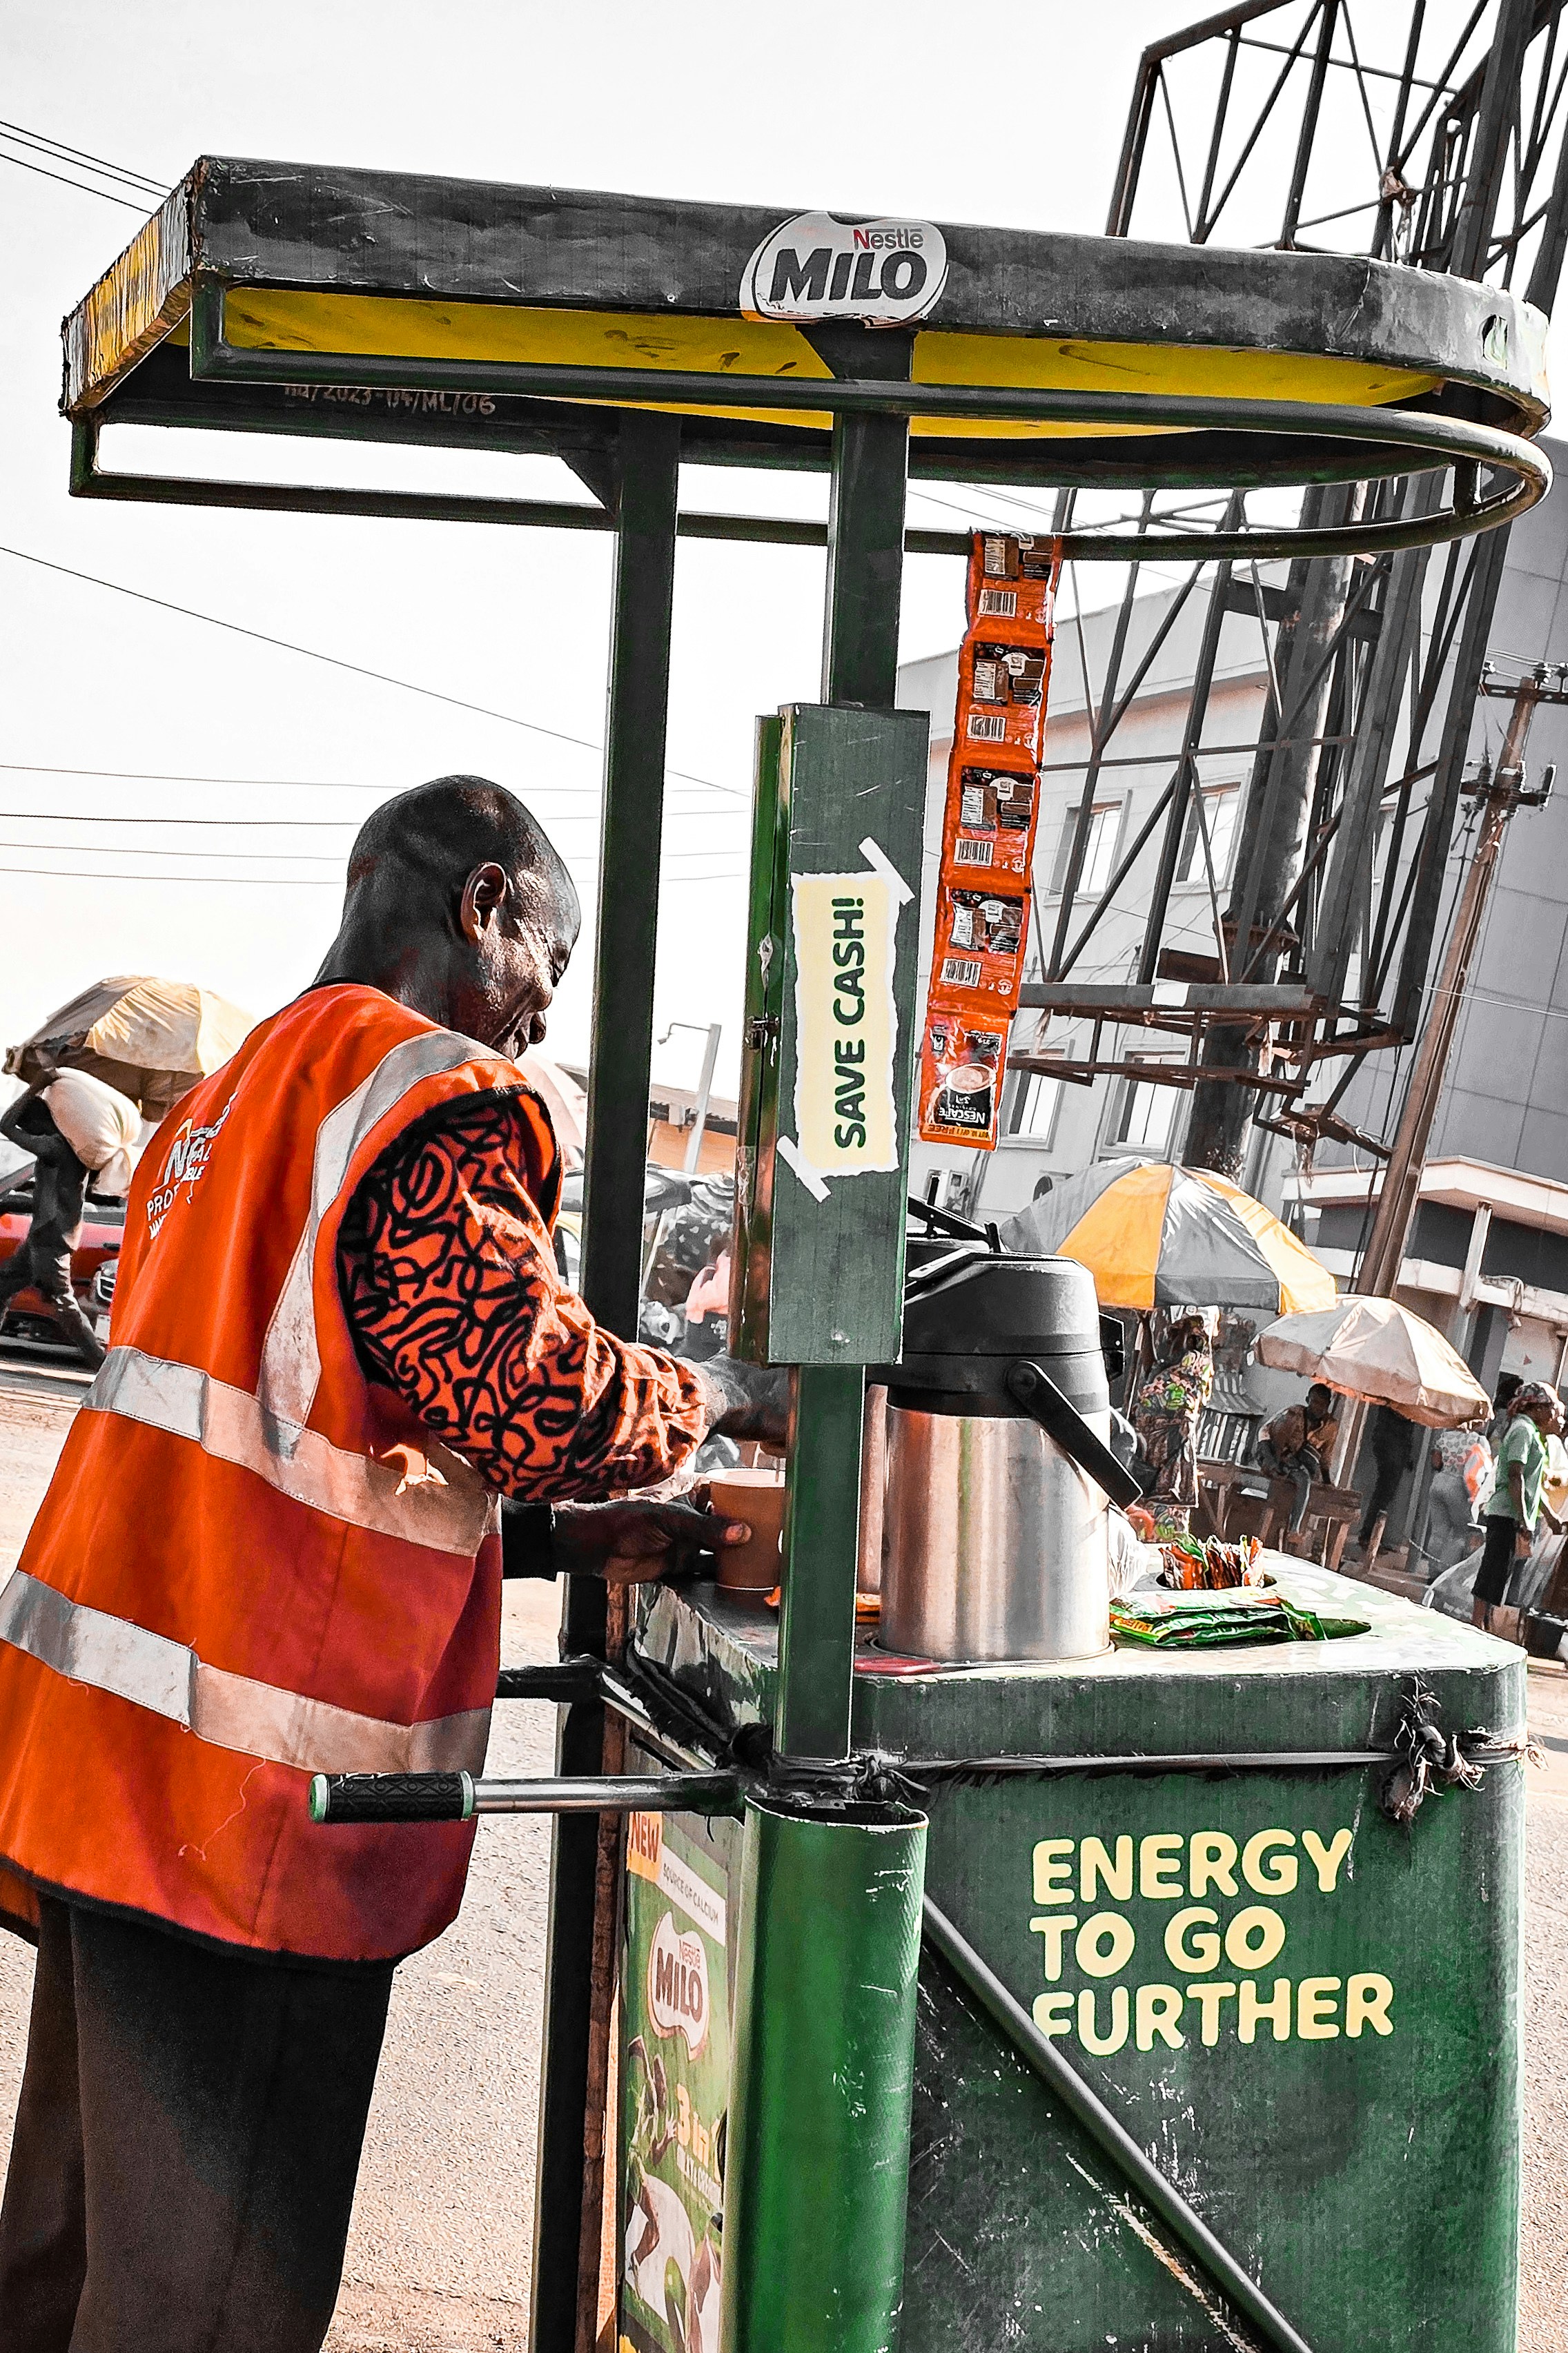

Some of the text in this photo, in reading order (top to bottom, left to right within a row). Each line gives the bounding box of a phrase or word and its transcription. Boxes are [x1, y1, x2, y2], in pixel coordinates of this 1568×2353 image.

[770, 248, 928, 302] MILO
[832, 897, 866, 1149] SAVE CASH!
[631, 1812, 660, 1863] NEW
[1032, 1828, 1353, 1905] ENERGY
[663, 1862, 719, 1926] SOURCE OF CALCIUM
[1029, 1905, 1286, 1982] TO GO
[656, 1946, 703, 2024] MILO
[1032, 1972, 1394, 2057] FURTHER
